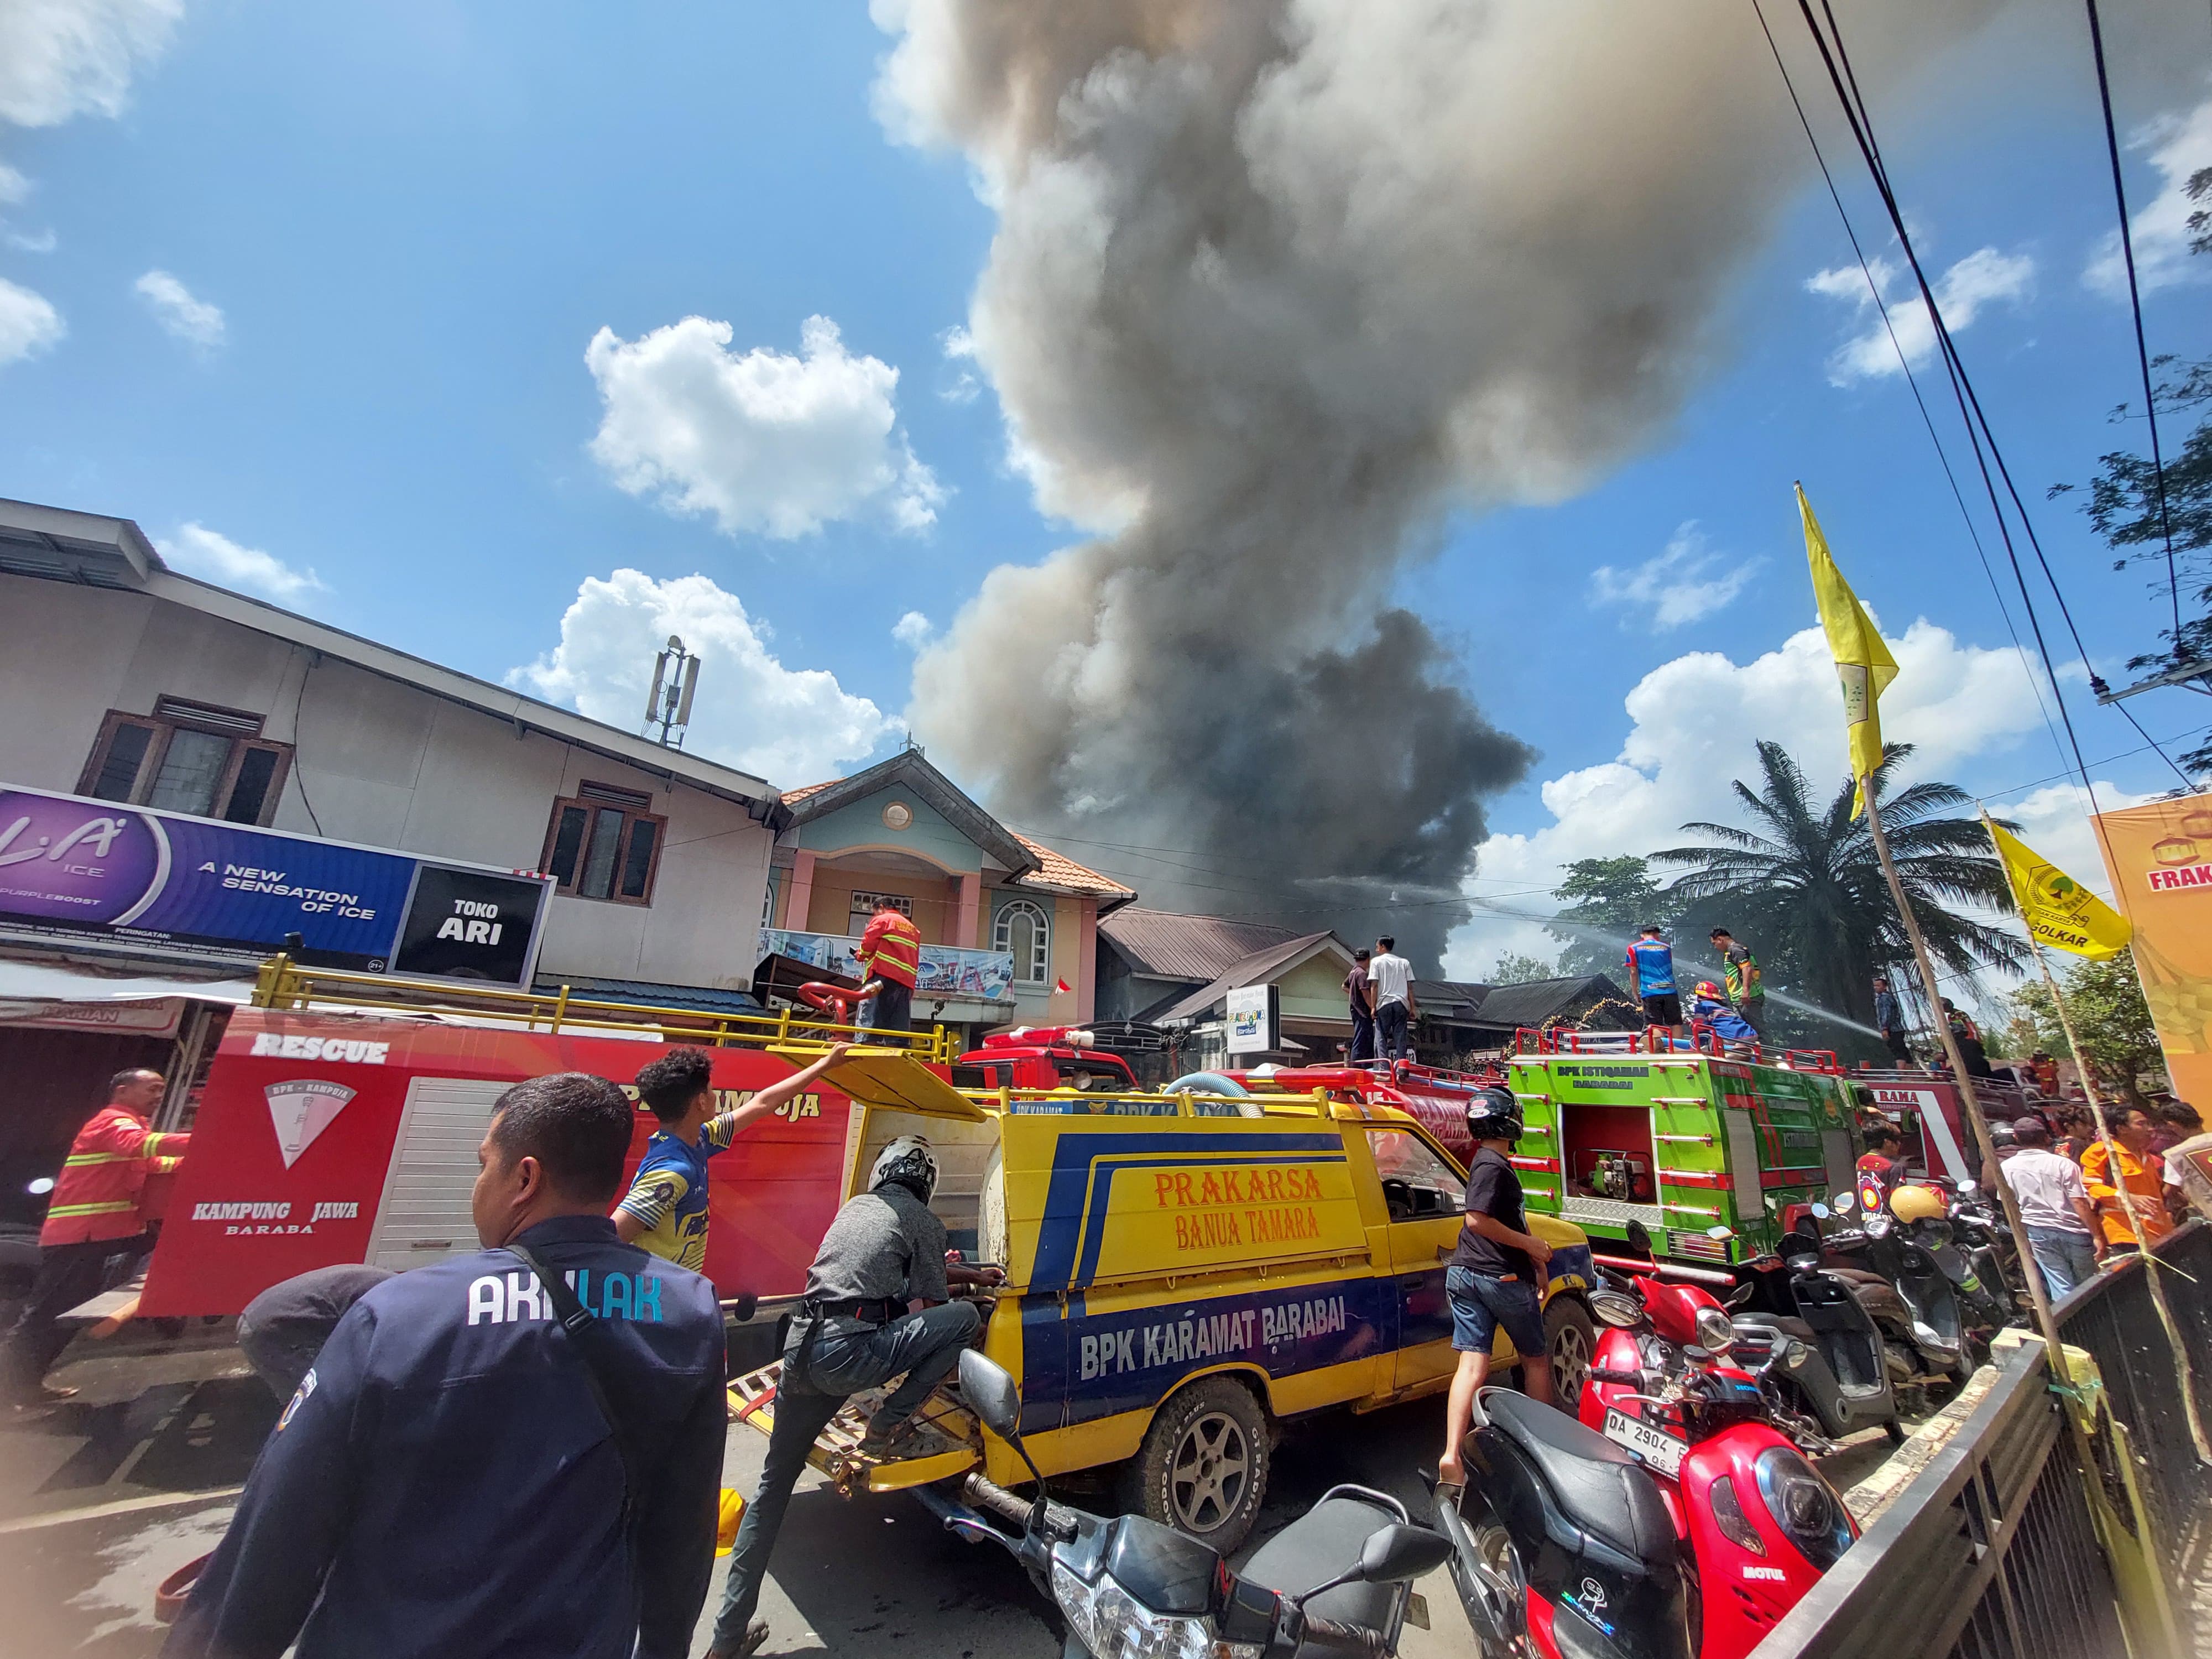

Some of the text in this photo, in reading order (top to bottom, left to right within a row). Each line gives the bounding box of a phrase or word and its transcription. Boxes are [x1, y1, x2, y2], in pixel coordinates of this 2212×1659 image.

[63, 864, 106, 878] ICE
[198, 862, 286, 881] A NEW
[222, 878, 358, 905] SENSATION
[301, 901, 376, 920] OF ICE
[454, 899, 498, 919] TOKO
[115, 927, 171, 939] PERINGATAN:
[436, 917, 503, 945] ARI
[250, 1032, 390, 1065] RESCUE
[1879, 1091, 1919, 1103] RAMA
[1154, 1168, 1324, 1208] PRAKARSA
[192, 1202, 359, 1223] KAMPUNG JAWA
[223, 1224, 314, 1235] BARABA
[1175, 1207, 1321, 1251] BANUA TAMARA
[1081, 1295, 1346, 1381] BPK KARAMAT BARABAI
[1183, 1401, 1205, 1423] PLUS
[1609, 1413, 1626, 1435] DA
[1634, 1425, 1669, 1453] 2904
[1240, 1453, 1262, 1520] RADIAL
[1743, 1566, 1786, 1581] MOTUL
